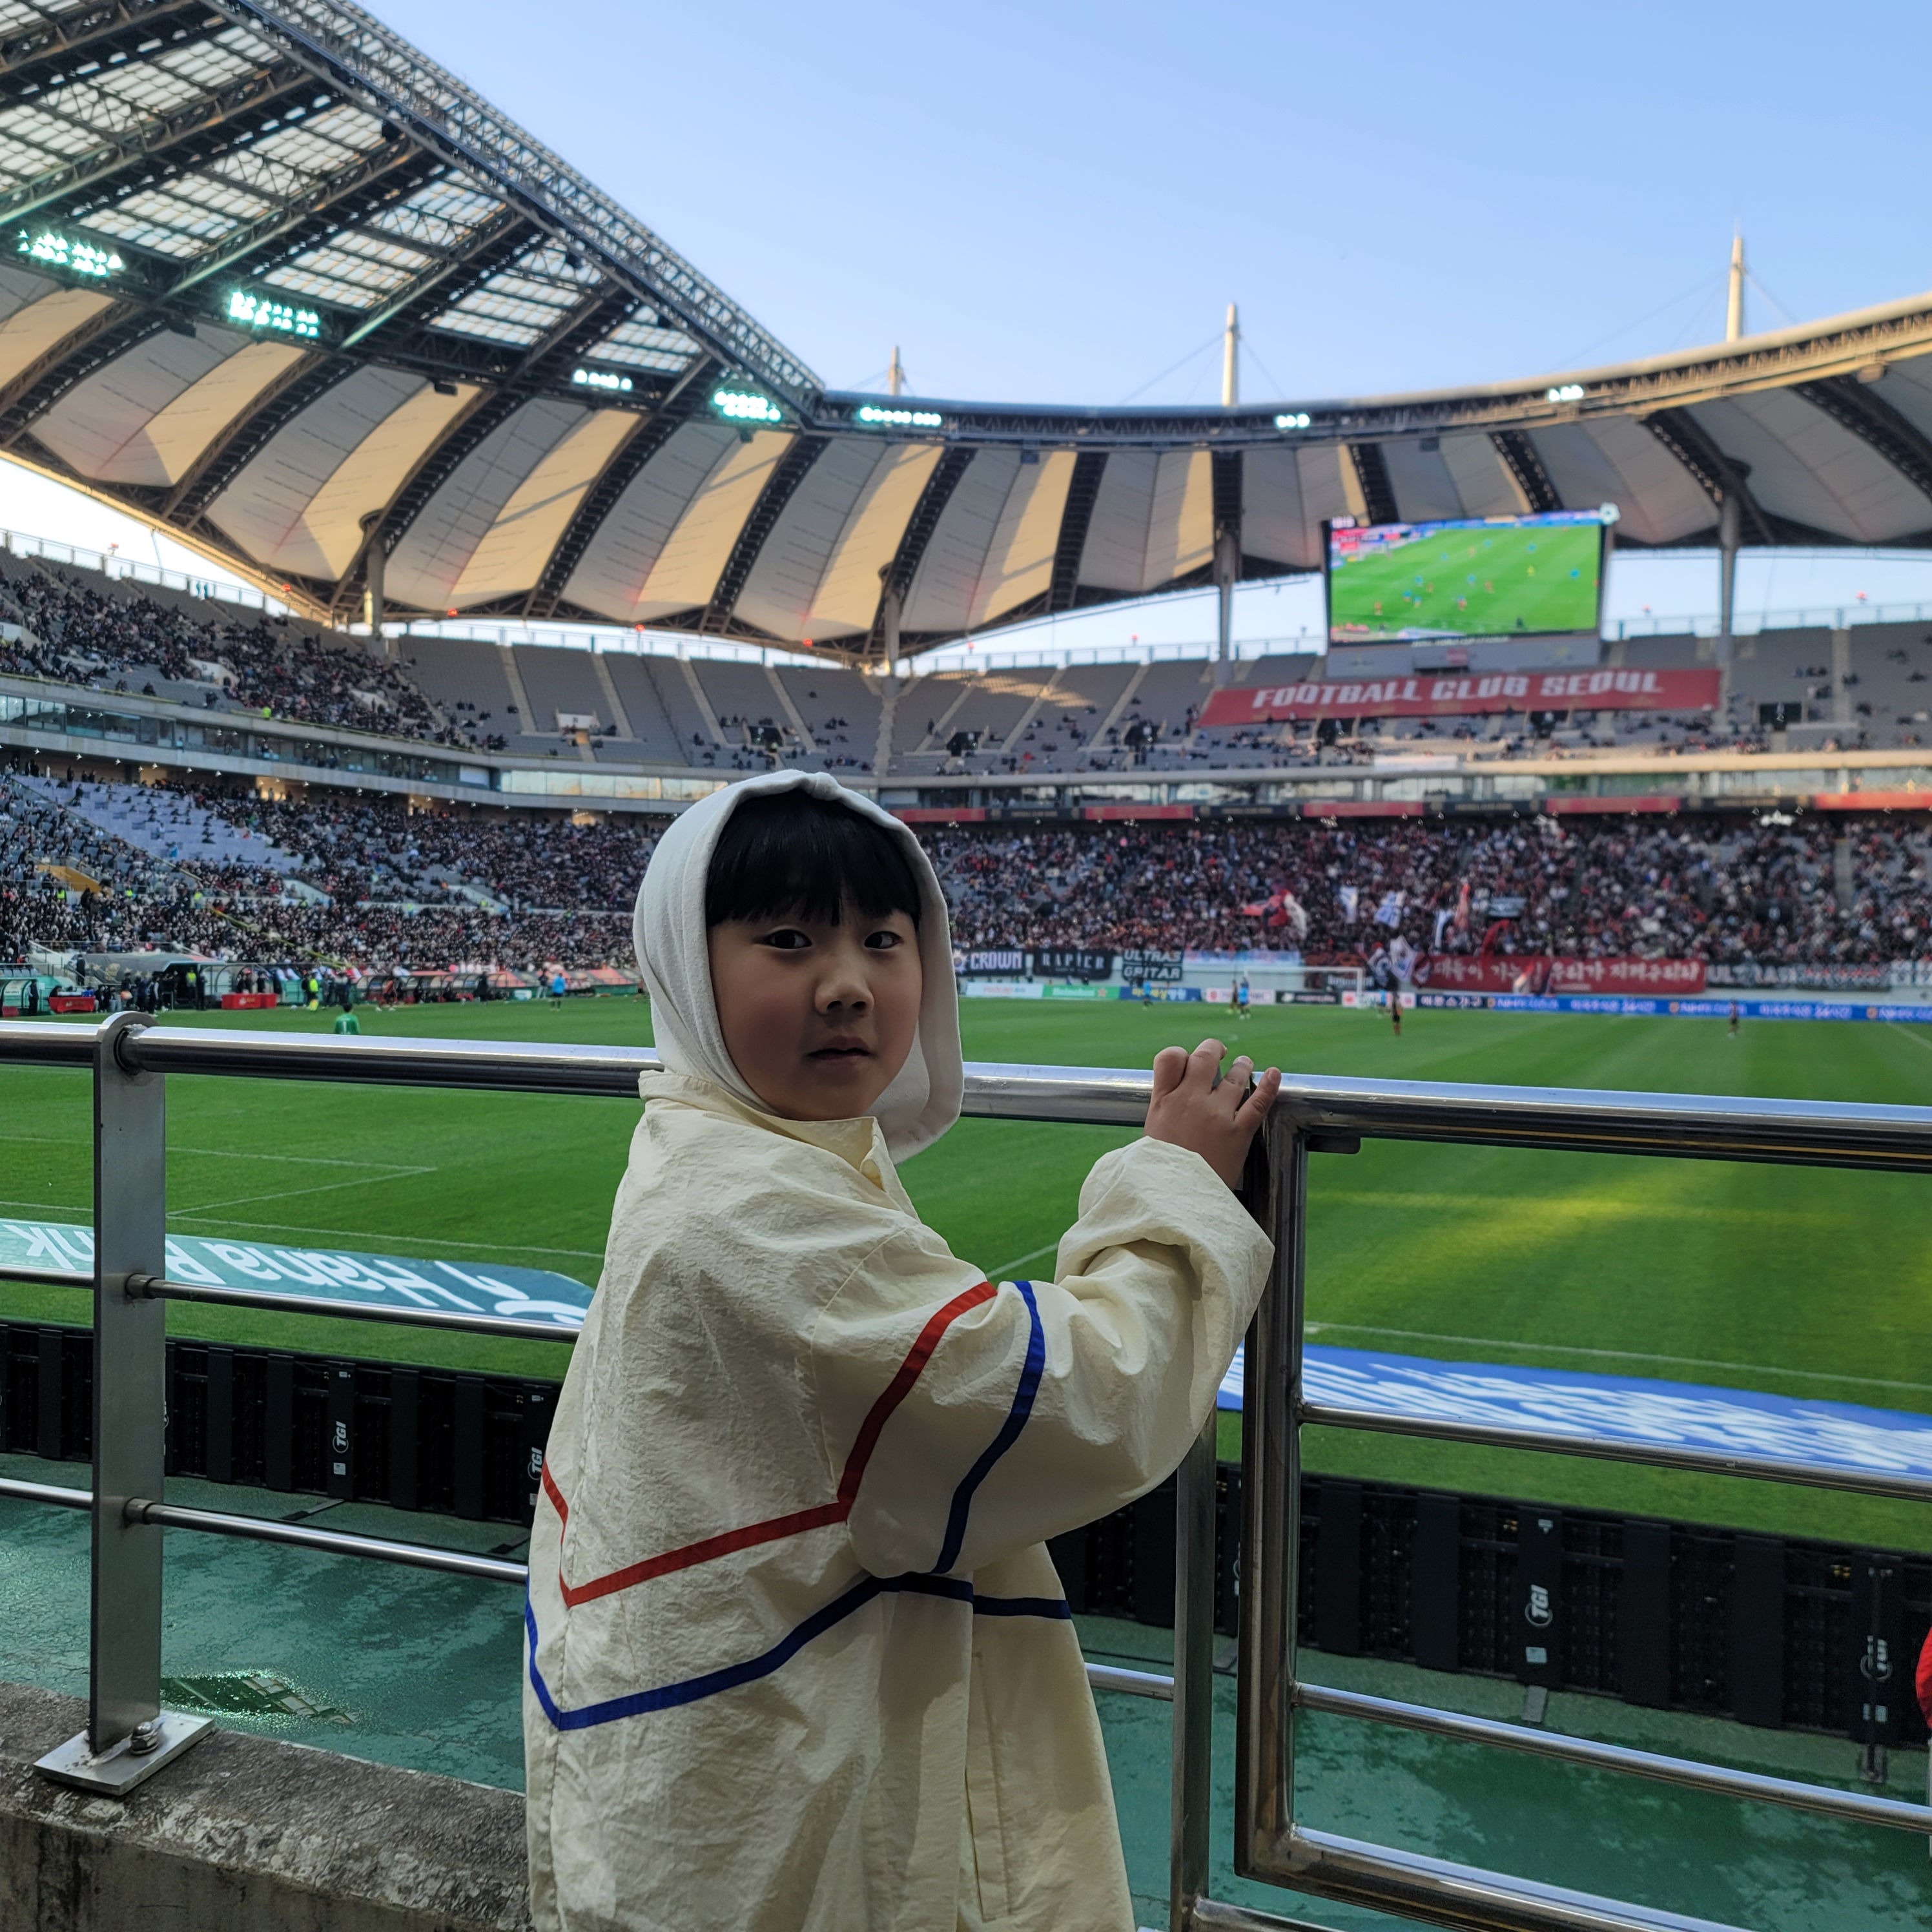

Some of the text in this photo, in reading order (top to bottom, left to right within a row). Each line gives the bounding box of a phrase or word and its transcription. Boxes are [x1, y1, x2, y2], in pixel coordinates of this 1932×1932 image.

[1252, 671, 1664, 708] FOOTBALL CLUB SEOUL
[971, 951, 1022, 969] CROWN
[1043, 952, 1105, 969] RAPIER
[3, 1224, 484, 1311] Hana Bnk
[335, 1421, 346, 1446] TGI
[531, 1447, 542, 1474] TGI
[1530, 1584, 1549, 1619] TGI
